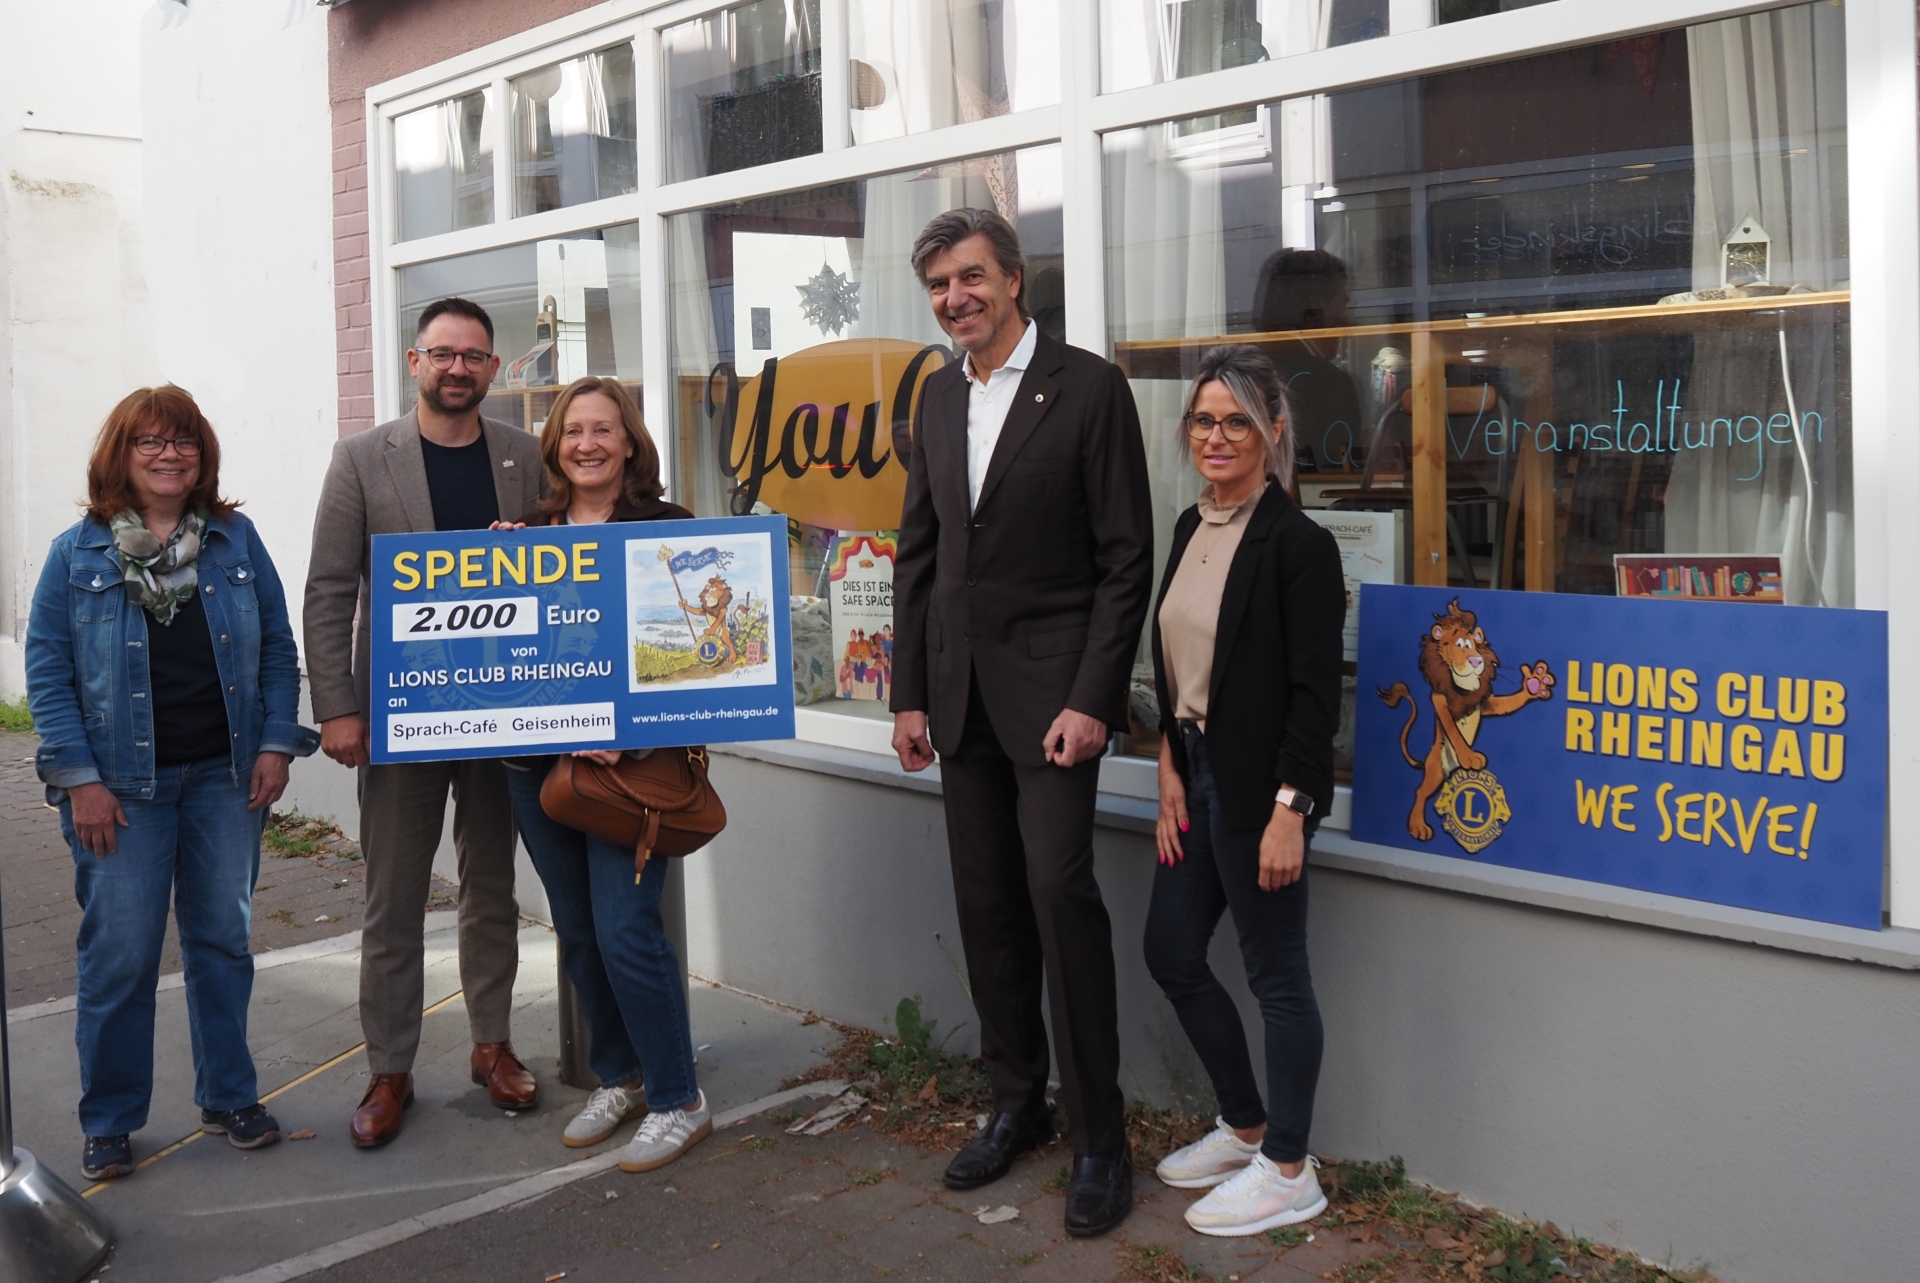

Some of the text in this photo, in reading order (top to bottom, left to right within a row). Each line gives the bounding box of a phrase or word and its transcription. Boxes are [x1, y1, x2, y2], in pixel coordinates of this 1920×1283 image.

[1445, 378, 1824, 481] Veranstaltungen
[393, 542, 600, 591] SPENDE
[675, 552, 712, 569] WE SERVE
[842, 594, 863, 606] SAFE
[843, 580, 894, 593] DIES IST EIN
[409, 603, 601, 633] 2.000 Euro
[511, 646, 538, 657] von
[389, 660, 612, 688] LIONS CLUB RHEINGAU
[388, 696, 407, 708] an
[1567, 660, 1847, 726] LIONS CLUB
[393, 713, 611, 740] Sprach-Café Geisenheim
[632, 706, 779, 724] www.lions-club-rheingau.de
[1565, 707, 1845, 782] RHEINGAU
[1455, 769, 1496, 788] LIONS
[1462, 790, 1484, 823] L
[1576, 779, 1818, 861] WE SERVE!
